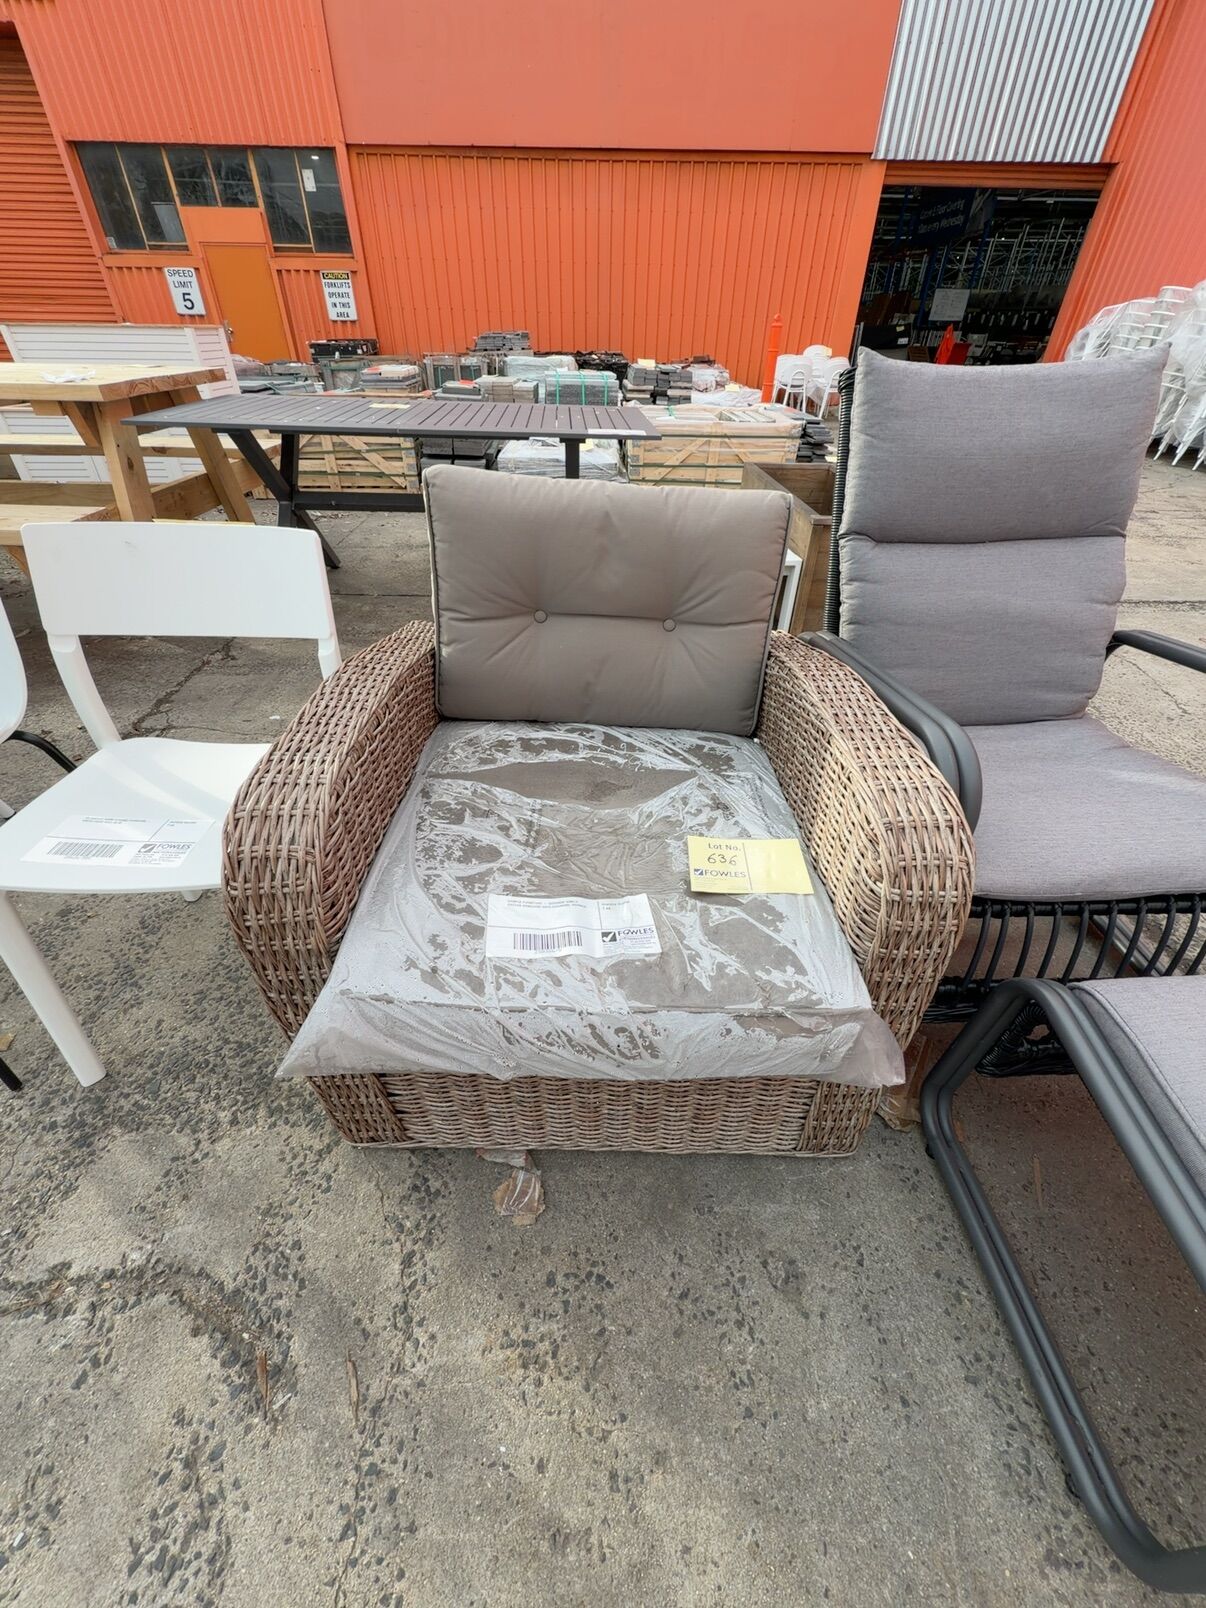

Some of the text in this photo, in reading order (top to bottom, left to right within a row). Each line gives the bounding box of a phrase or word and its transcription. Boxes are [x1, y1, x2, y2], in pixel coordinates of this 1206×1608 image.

[166, 268, 194, 278] SPEED
[172, 280, 193, 289] LIMIT
[323, 281, 351, 289] FORKLIFTS
[327, 291, 351, 299] OPERATE
[181, 292, 195, 310] 5
[331, 301, 351, 309] IN THIS
[708, 842, 742, 852] Lot No.
[706, 852, 738, 866] 636
[704, 869, 747, 878] FOWLES
[617, 927, 655, 938] FOWLES
